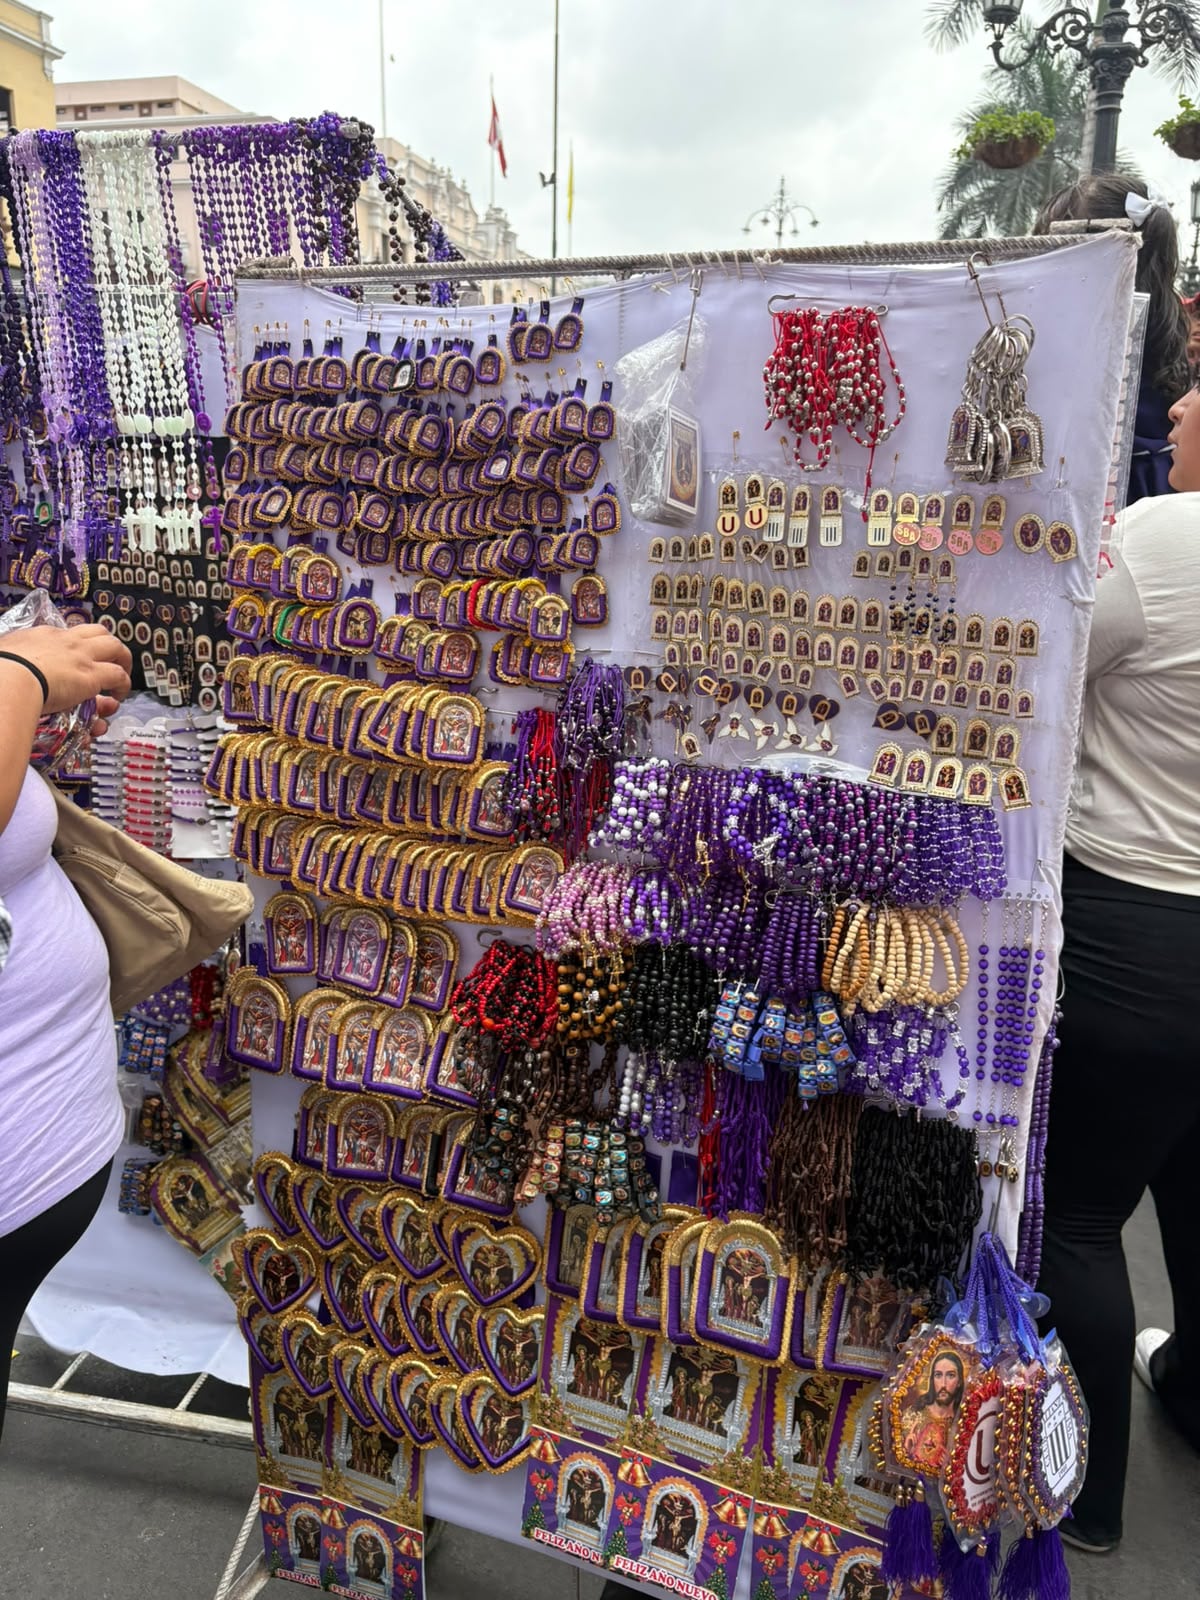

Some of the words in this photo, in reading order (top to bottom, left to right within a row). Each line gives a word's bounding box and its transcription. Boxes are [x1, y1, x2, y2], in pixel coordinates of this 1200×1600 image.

[896, 526, 916, 542] SBA
[534, 1528, 565, 1547] FELIZ
[566, 1541, 590, 1557] AÑO
[615, 1557, 648, 1576] FELIZ
[649, 1568, 676, 1587] AÑO
[676, 1582, 718, 1600] NUEVO
